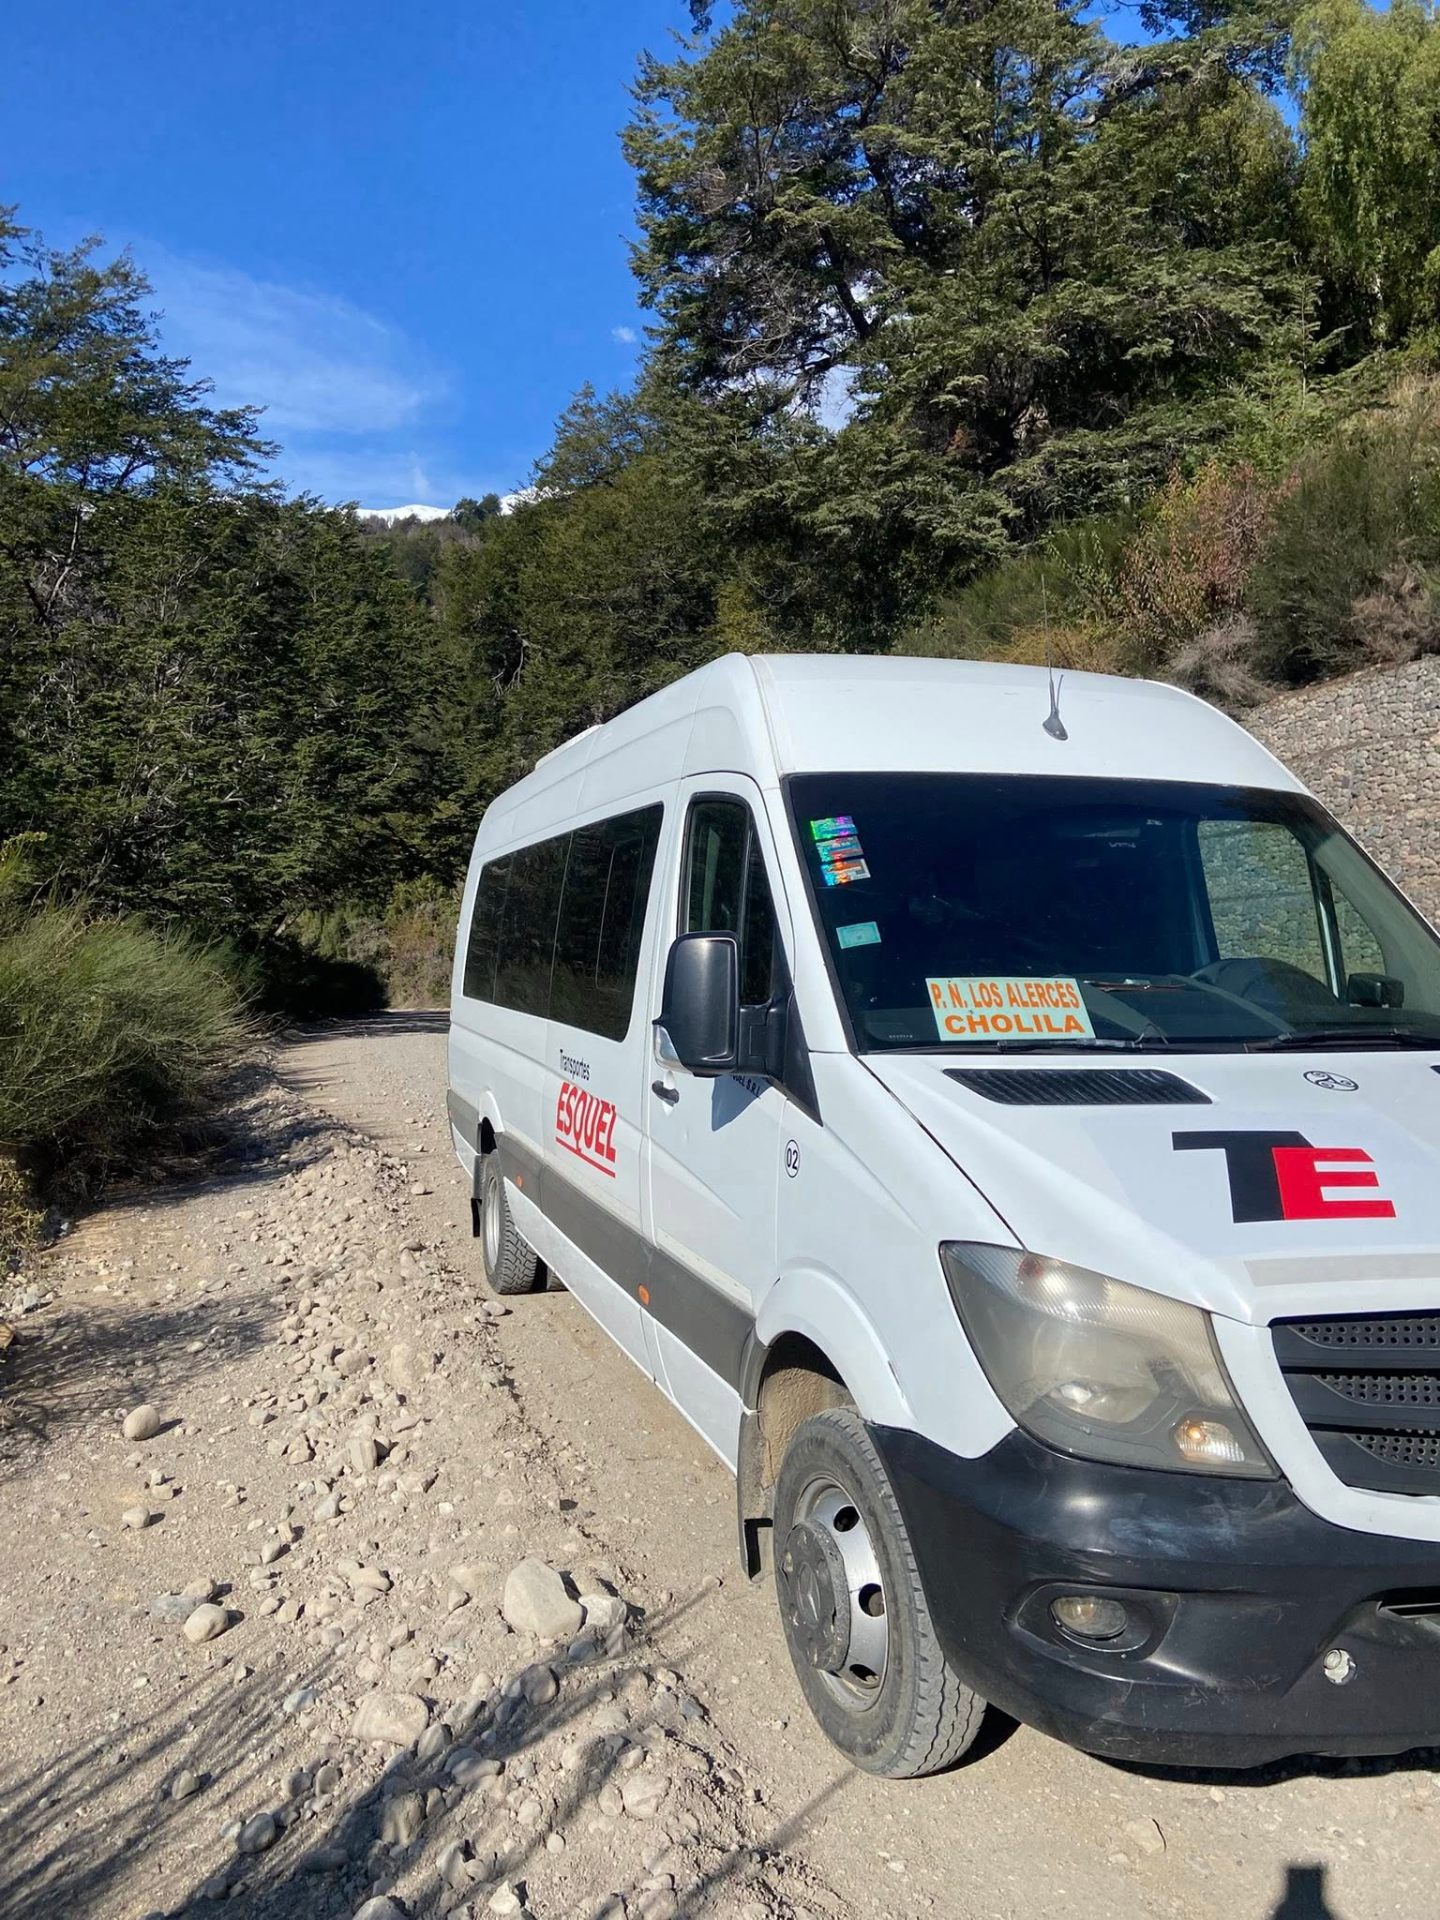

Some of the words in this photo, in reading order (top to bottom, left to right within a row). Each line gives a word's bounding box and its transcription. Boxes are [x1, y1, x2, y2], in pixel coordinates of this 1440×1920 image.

[969, 982, 1004, 1008] LOS
[1006, 982, 1080, 1009] ALERCES
[944, 1014, 1085, 1034] CHOLILA
[560, 1049, 590, 1080] Transportes
[556, 1081, 616, 1163] ESQUEL
[786, 1147, 799, 1170] 02
[1172, 1131, 1397, 1223] TE
